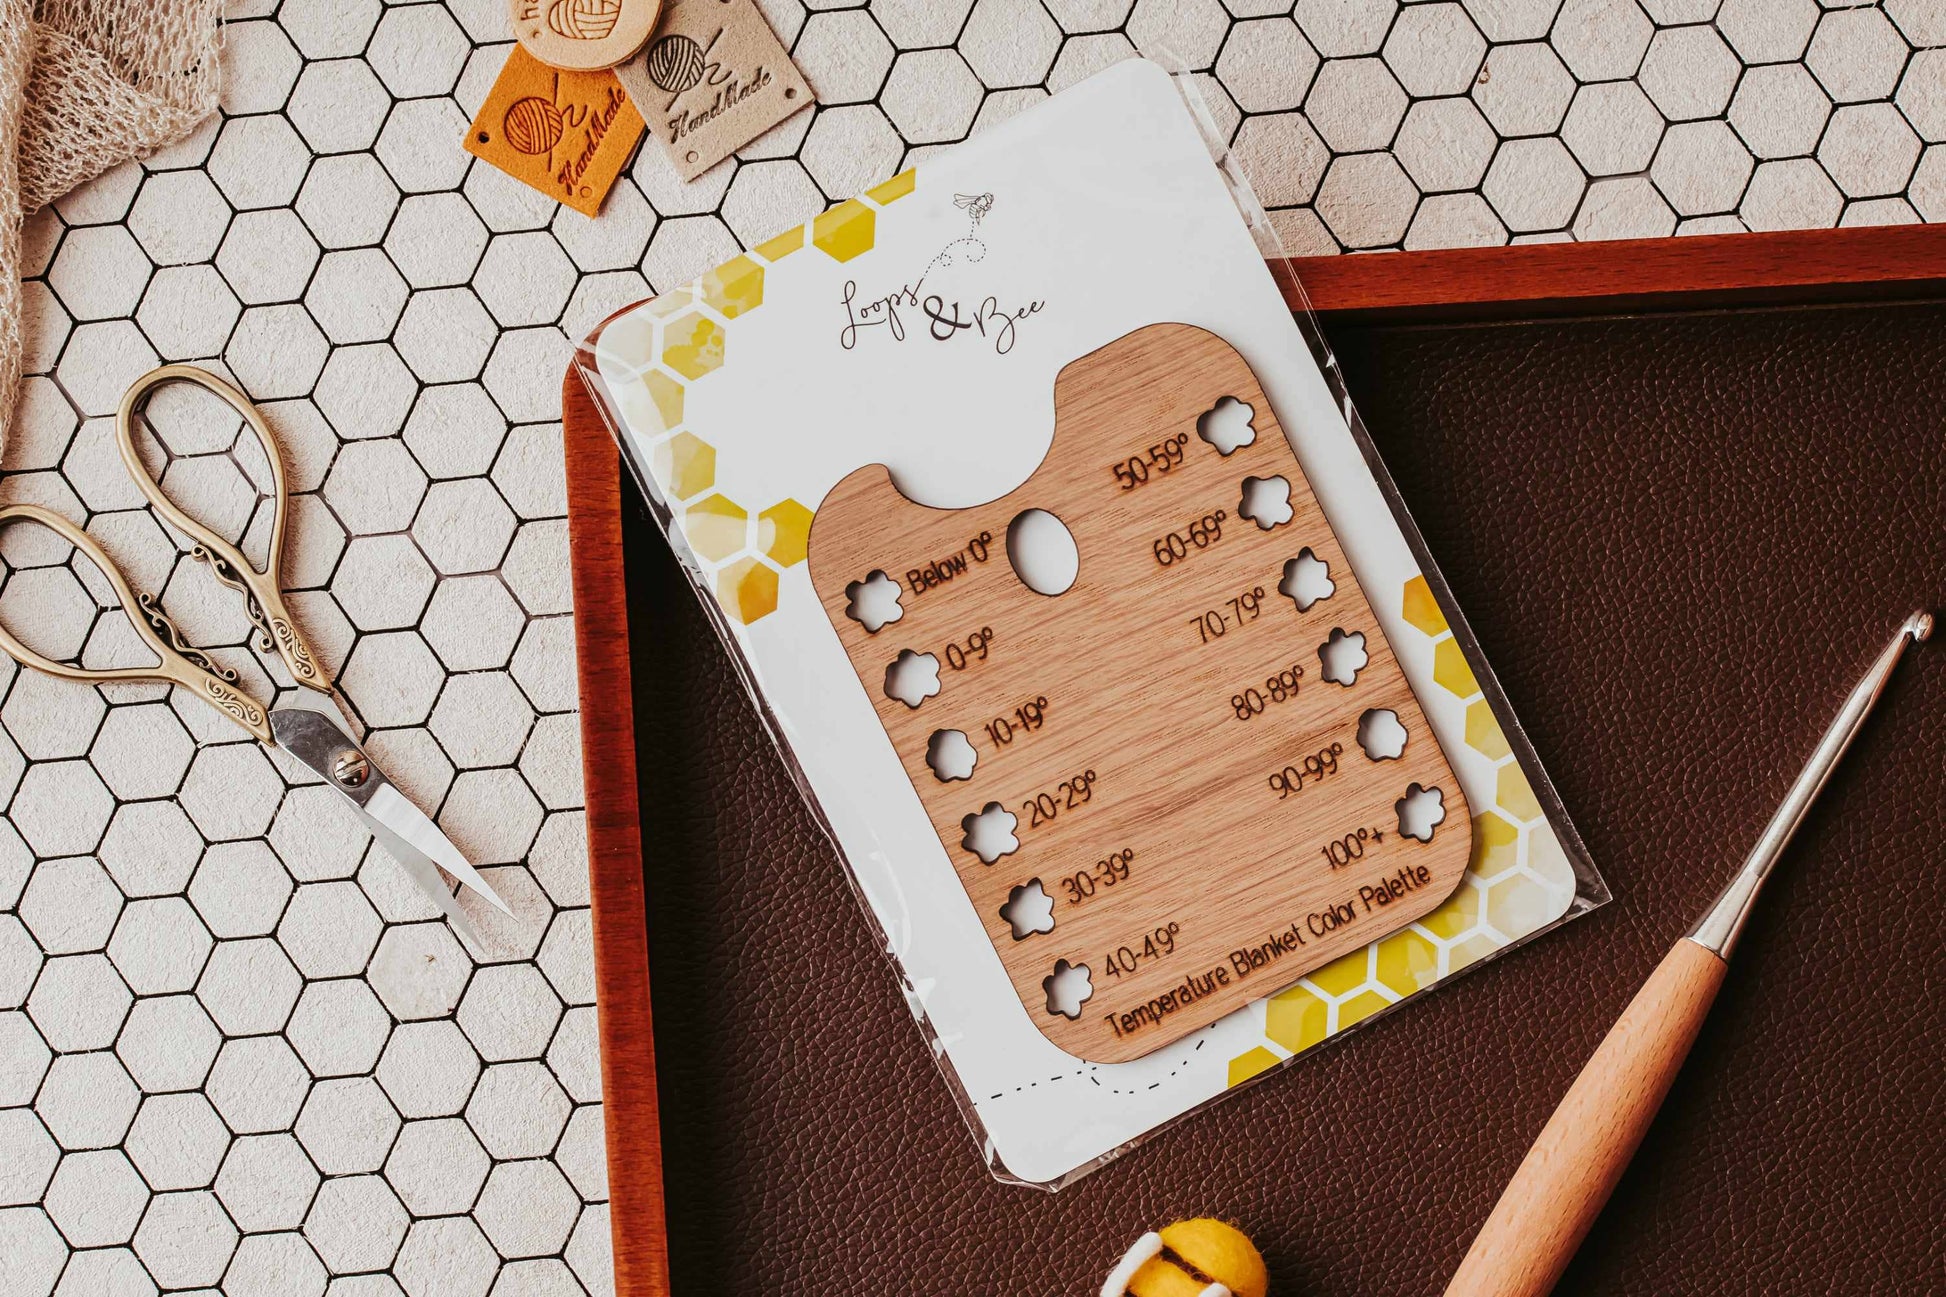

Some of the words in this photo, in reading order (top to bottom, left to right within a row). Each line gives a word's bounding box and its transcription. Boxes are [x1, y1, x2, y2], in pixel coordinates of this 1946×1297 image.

[556, 86, 627, 197] HandMade
[667, 65, 773, 145] HandMade
[840, 277, 924, 350] Loops
[922, 295, 973, 341] &
[972, 296, 1046, 355] Bee
[905, 550, 969, 596] Below
[1103, 964, 1230, 1039] Temperature
[1228, 922, 1307, 979] Blanket
[1306, 898, 1357, 938] Color
[1358, 864, 1432, 913] Palette
